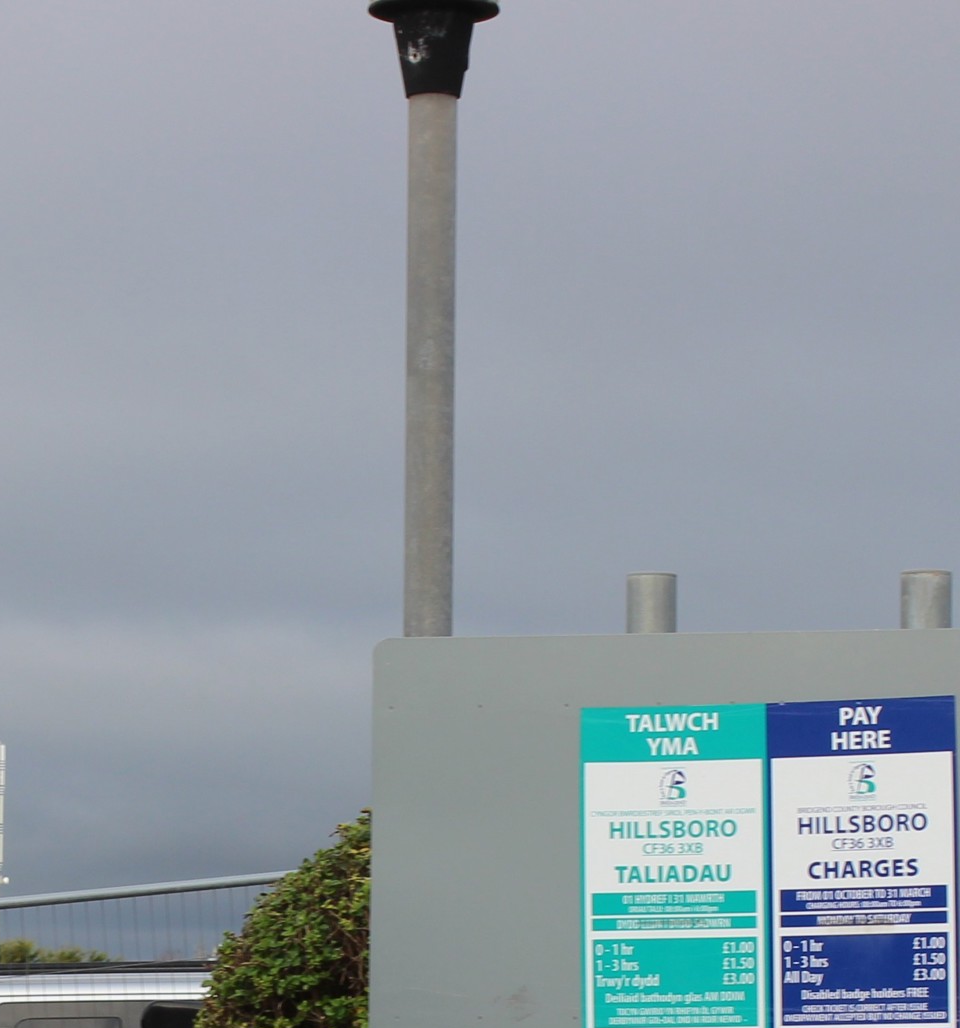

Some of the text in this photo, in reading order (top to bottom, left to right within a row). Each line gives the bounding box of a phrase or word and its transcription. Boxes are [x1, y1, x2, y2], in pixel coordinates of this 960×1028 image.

[625, 712, 719, 733] TALWCH
[839, 706, 883, 727] PAY
[647, 737, 699, 757] YMA
[831, 730, 892, 751] HERE
[609, 819, 738, 840] HILLSBORO
[797, 812, 928, 835] HILLSBORO
[642, 843, 675, 856] CF36
[831, 838, 865, 851] CF36
[615, 864, 732, 884] TALIADAU
[808, 858, 919, 880] CHARGES
[595, 944, 603, 956] 0
[612, 944, 619, 956] 1
[620, 943, 634, 956] hr
[722, 941, 754, 954] £1.00
[783, 940, 792, 953] 0
[802, 940, 808, 952] 1
[809, 939, 824, 952] hr
[912, 937, 946, 950] £1.00
[596, 960, 603, 971] 1
[611, 959, 620, 971] 3
[620, 958, 640, 971] hrs
[722, 957, 755, 970] £1.50
[784, 956, 792, 968] 1
[800, 956, 809, 968] 3
[809, 955, 829, 968] hrs
[912, 952, 946, 966] £1.50
[722, 973, 755, 985] £3.00
[783, 971, 824, 986] All Day
[912, 968, 946, 981] £3.00
[632, 974, 660, 990] dydd
[801, 989, 840, 1000] Disabled
[841, 988, 870, 1001] badge
